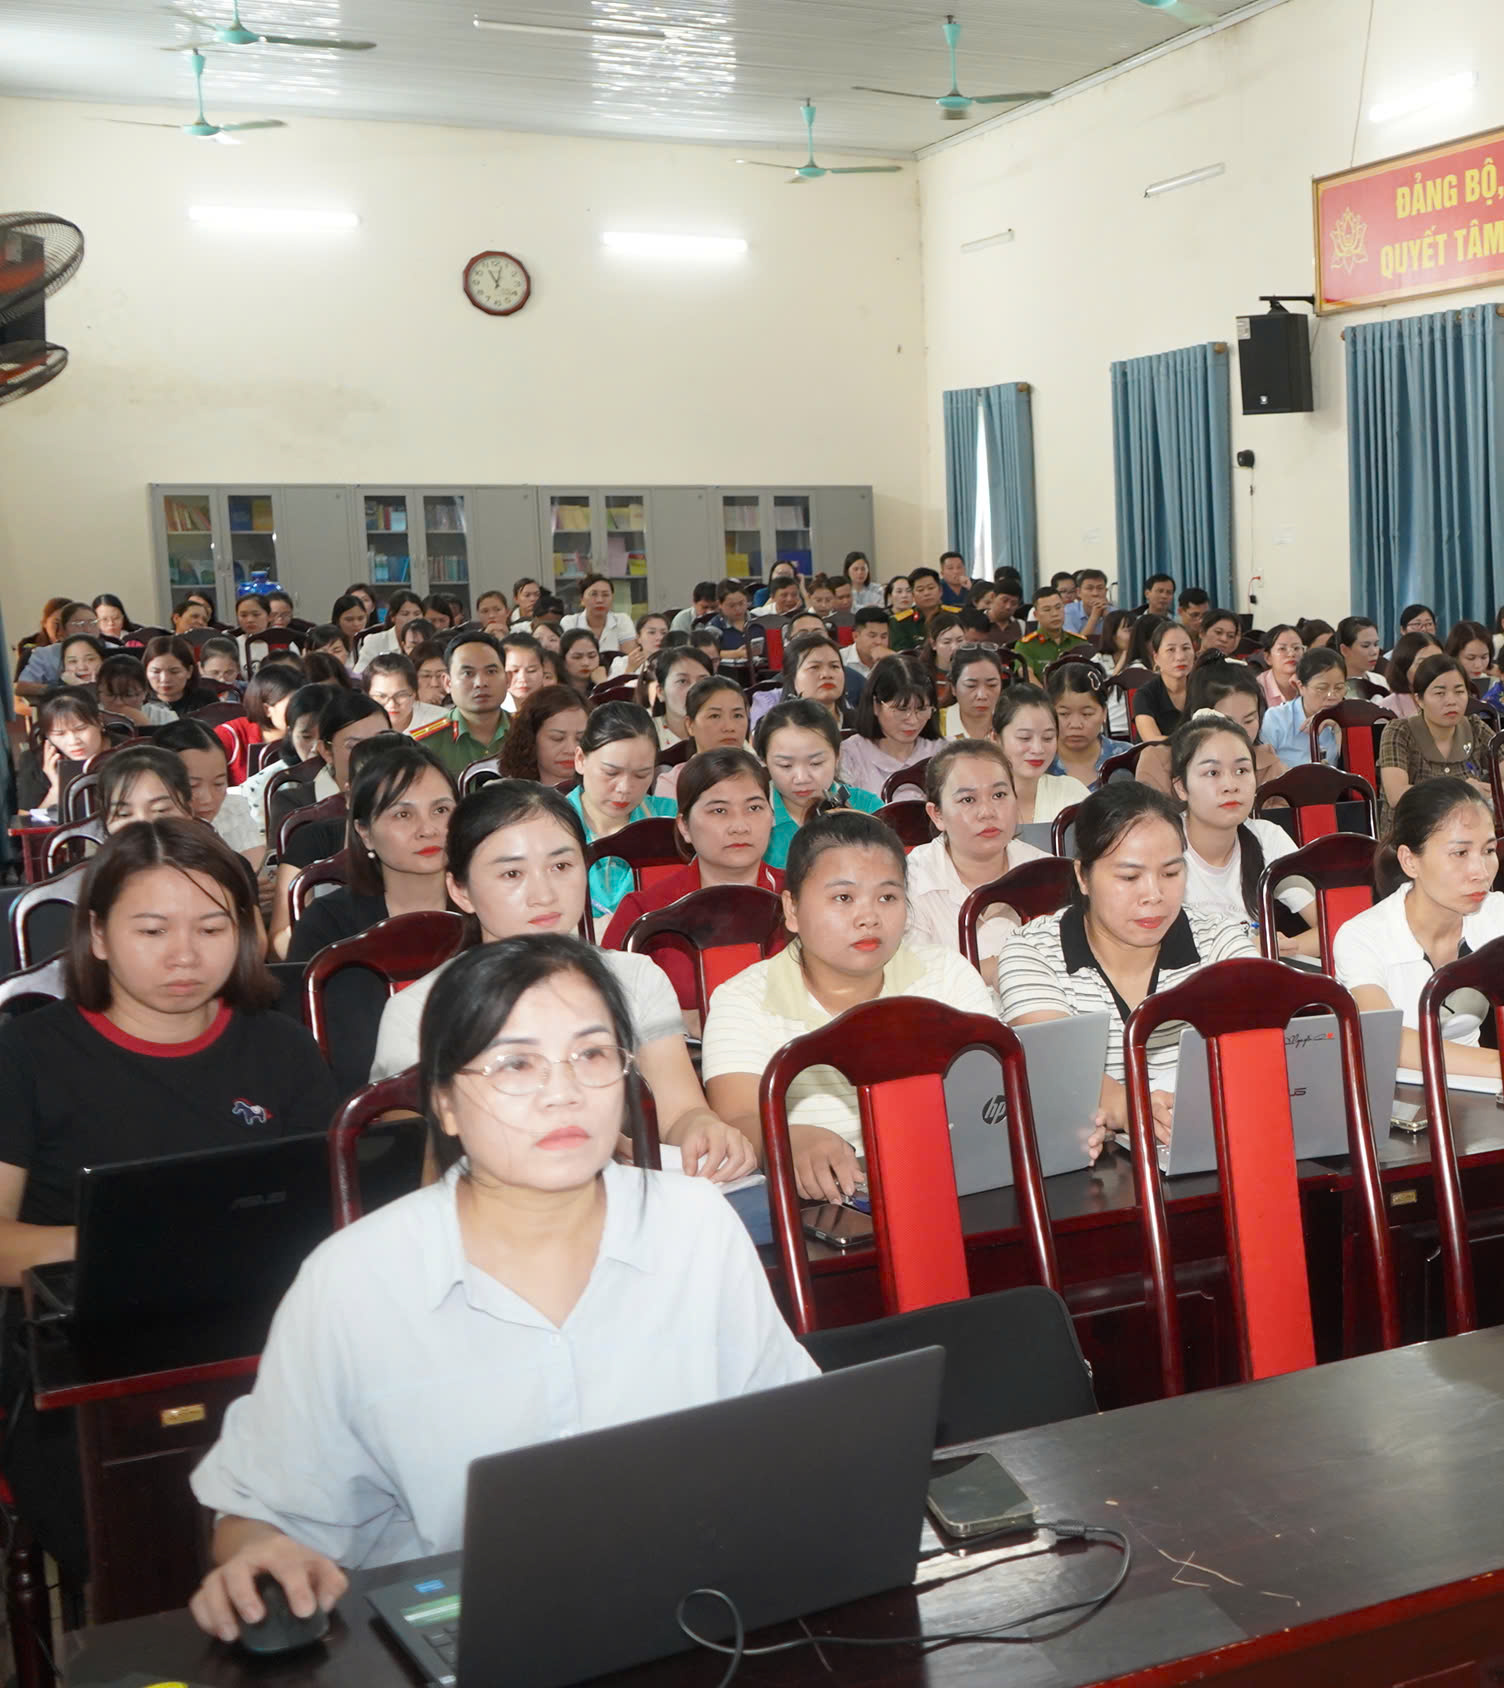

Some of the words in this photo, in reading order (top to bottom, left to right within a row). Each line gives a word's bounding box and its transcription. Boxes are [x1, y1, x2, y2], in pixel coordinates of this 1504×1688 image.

[1396, 172, 1458, 219] ĐẢNG
[1464, 157, 1504, 206] BỘ,
[1380, 225, 1448, 279] QUYẾT
[1454, 219, 1504, 262] TÂM
